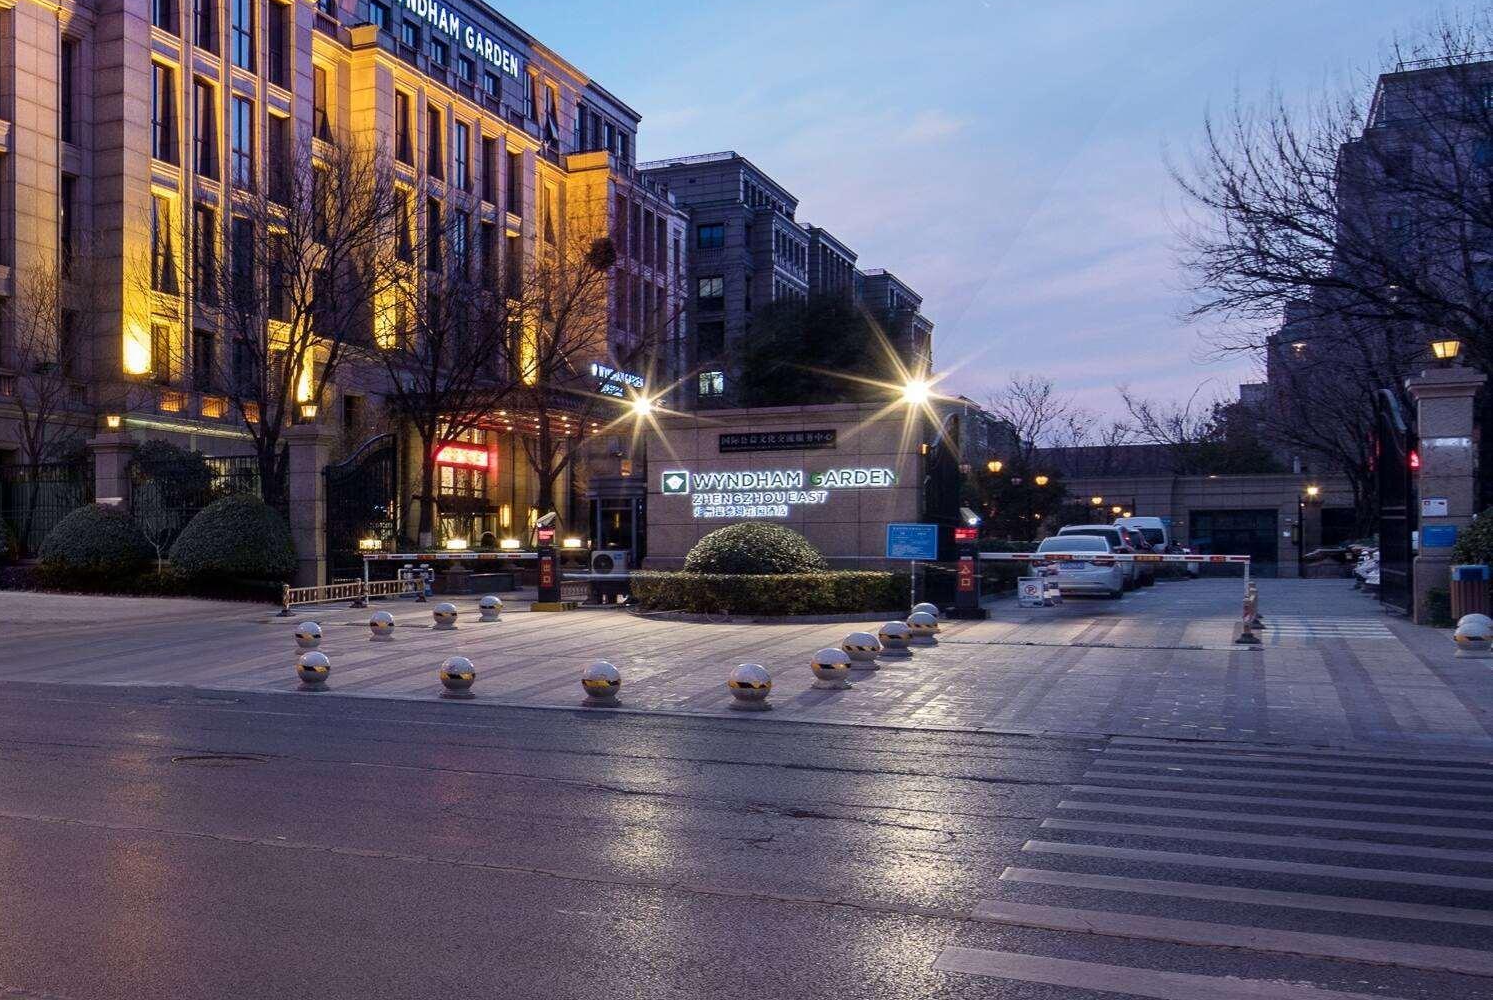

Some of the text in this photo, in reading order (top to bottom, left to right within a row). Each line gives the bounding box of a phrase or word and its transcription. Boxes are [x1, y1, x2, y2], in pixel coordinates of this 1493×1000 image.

[465, 26, 519, 78] GARDEN
[692, 469, 899, 490] WYNDHAM GARDEN
[692, 491, 828, 505] ZHENGZHOU EAST
[960, 564, 972, 586] 入口
